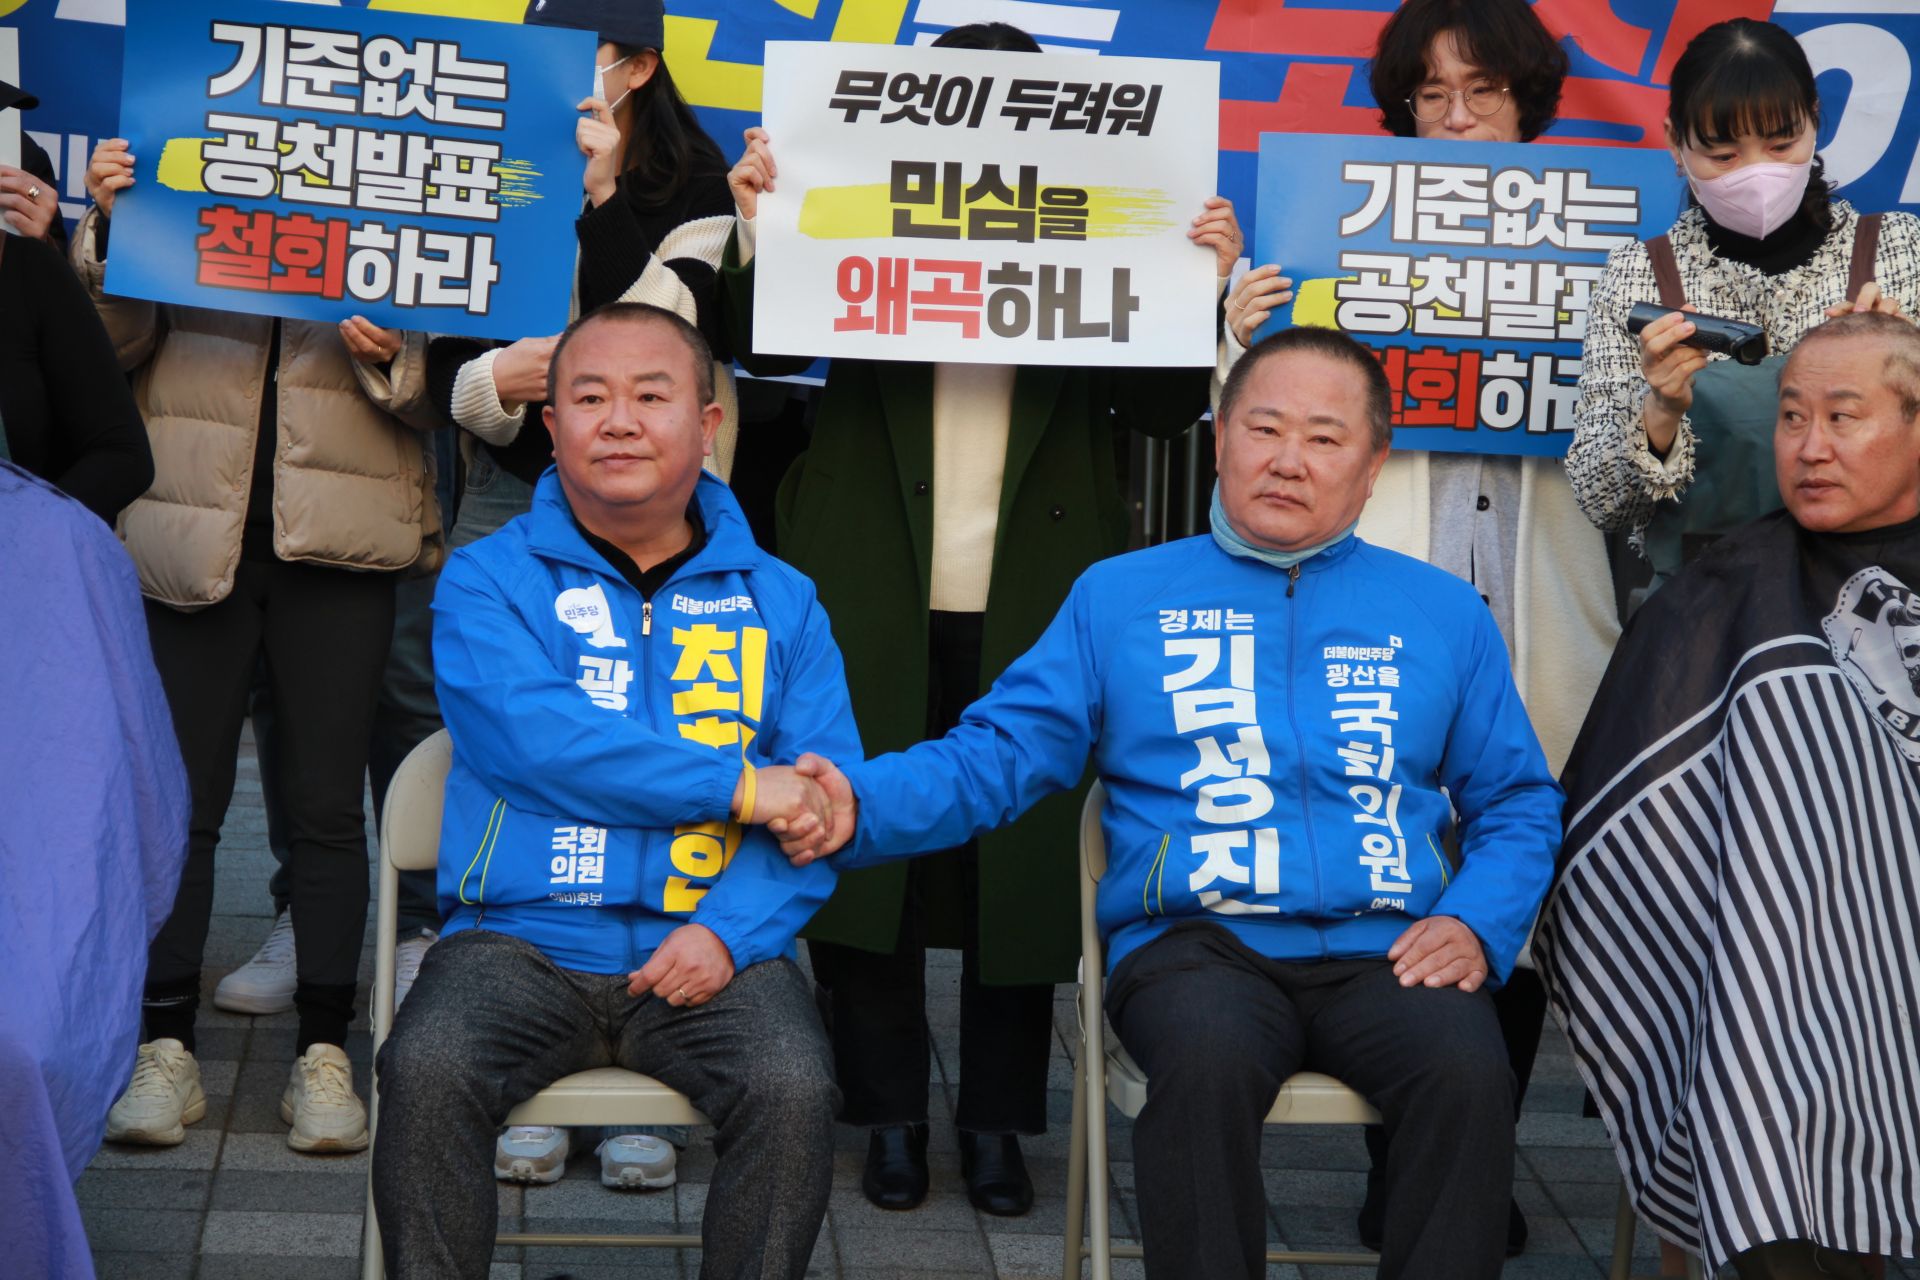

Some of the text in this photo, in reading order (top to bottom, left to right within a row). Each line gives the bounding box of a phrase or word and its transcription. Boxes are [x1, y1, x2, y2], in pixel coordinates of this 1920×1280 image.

[208, 20, 508, 130] 기준없는
[829, 70, 1162, 136] 무엇이 두려워
[202, 112, 501, 221] 공천발표
[889, 160, 1089, 243] 민심을
[1340, 161, 1640, 250] 기준없는
[197, 205, 498, 315] 철회하라
[834, 256, 1140, 343] 왜곡하나
[564, 605, 599, 620] 민주당
[672, 594, 758, 615] 더불어민주
[1159, 608, 1254, 633] 경제는
[1324, 646, 1395, 661] 더불어민주당
[1326, 664, 1400, 688] 광산을
[1163, 635, 1280, 915] 김성진
[1330, 692, 1413, 893] 국회의원
[550, 855, 605, 884] 의원
[552, 826, 607, 854] 국회
